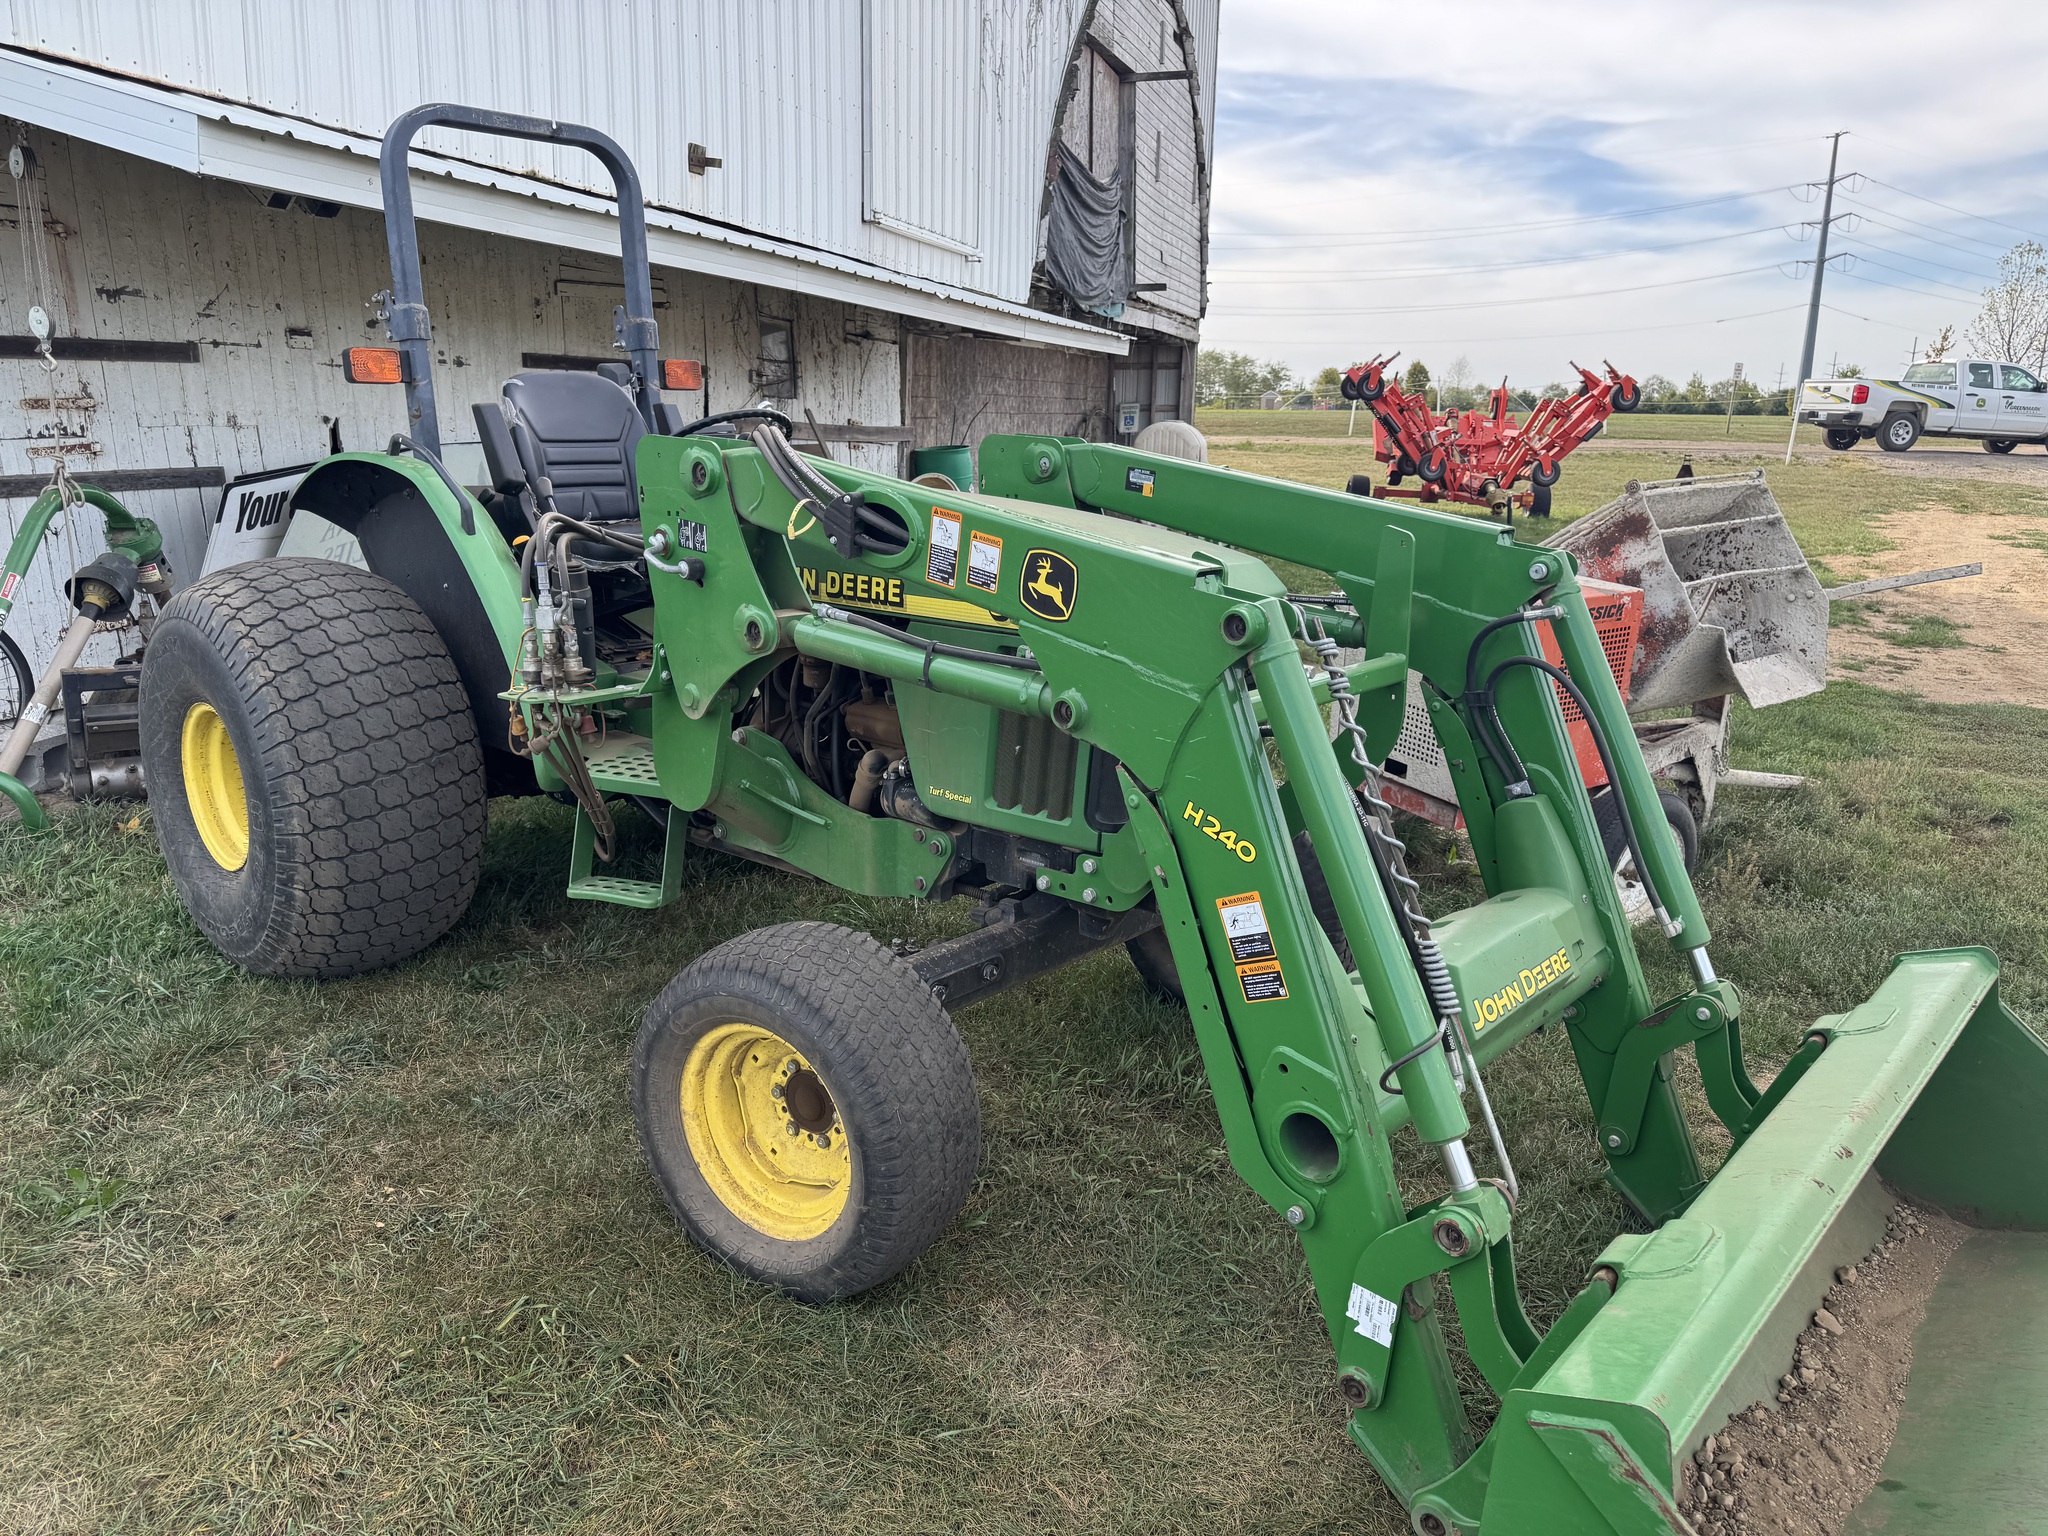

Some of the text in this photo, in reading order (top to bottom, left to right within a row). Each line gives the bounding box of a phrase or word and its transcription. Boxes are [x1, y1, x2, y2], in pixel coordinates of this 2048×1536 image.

[235, 490, 290, 534] Your
[939, 510, 961, 520] WARNING
[979, 535, 1001, 547] WARNING
[826, 570, 902, 604] DEERE
[929, 785, 972, 804] Turf Special
[1183, 801, 1257, 863] H240
[1227, 894, 1256, 905] WARNING
[1247, 963, 1276, 973] WARNING
[1473, 947, 1571, 1031] JOHN DEERE
